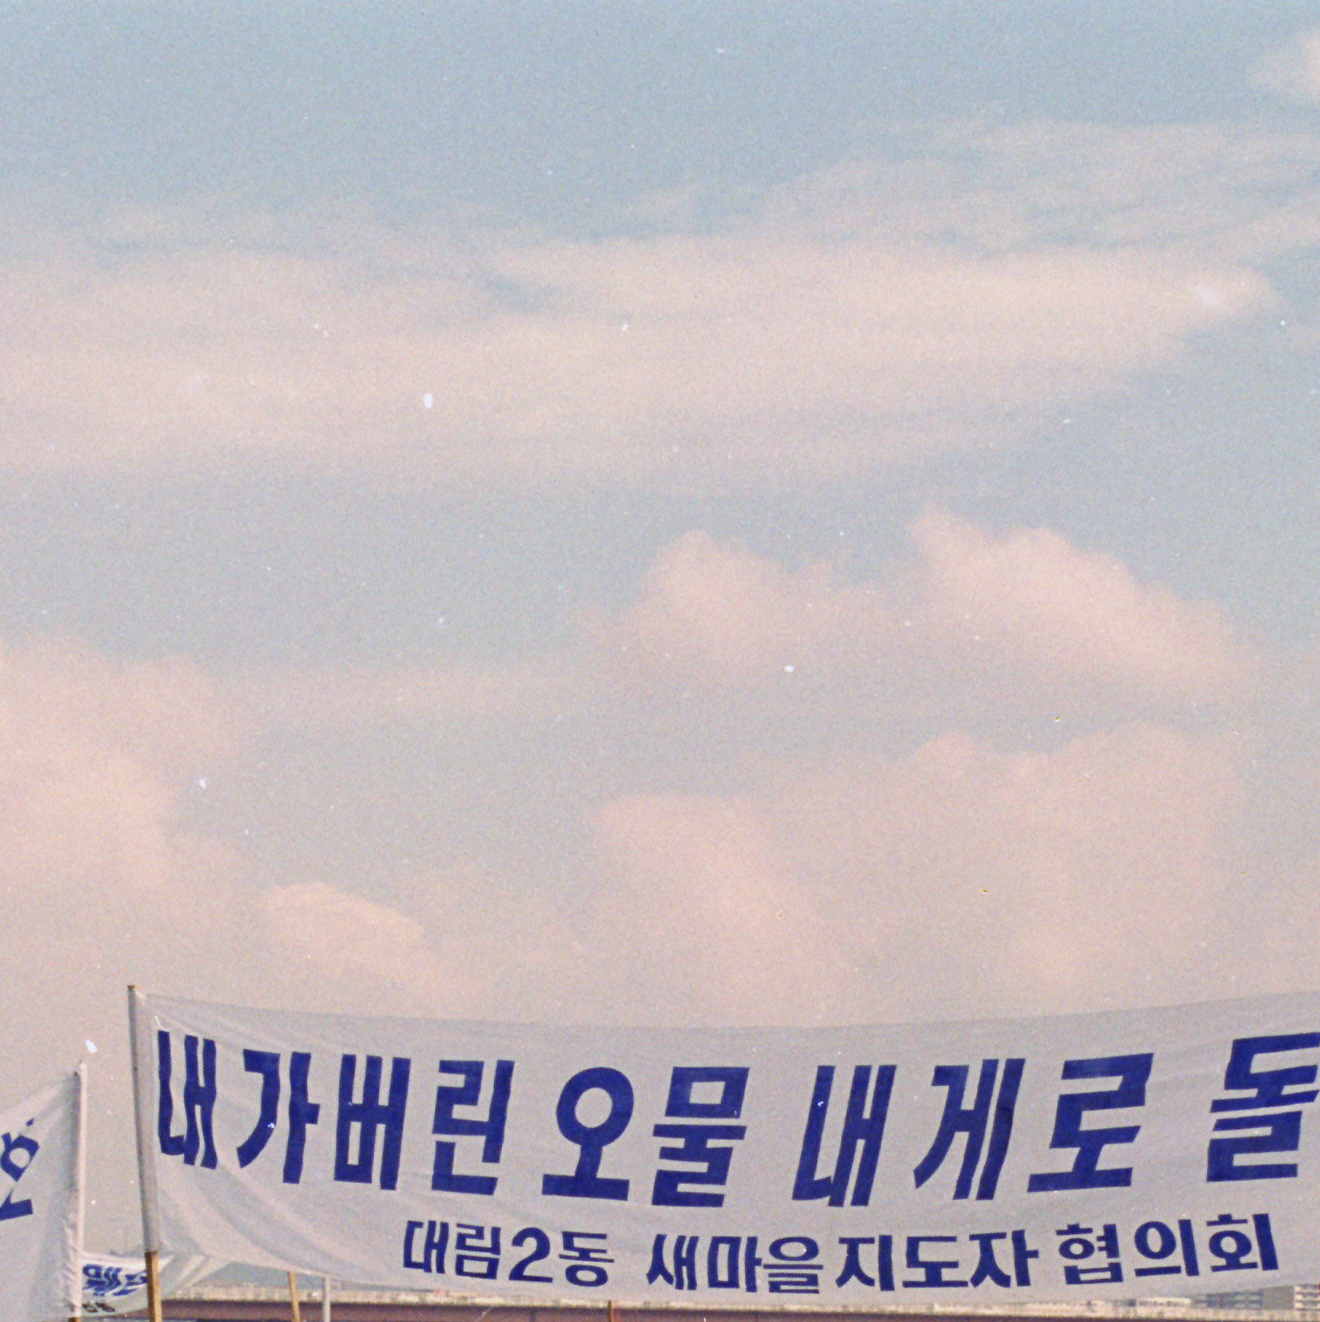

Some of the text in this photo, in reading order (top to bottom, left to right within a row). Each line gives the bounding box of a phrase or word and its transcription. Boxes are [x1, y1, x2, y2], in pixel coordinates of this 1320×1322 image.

[156, 1029, 515, 1194] 내가버린
[542, 1065, 750, 1208] 오물
[791, 1052, 1154, 1208] 내게로
[402, 1220, 615, 1288] 대림2동
[1057, 1213, 1279, 1286] 협의회
